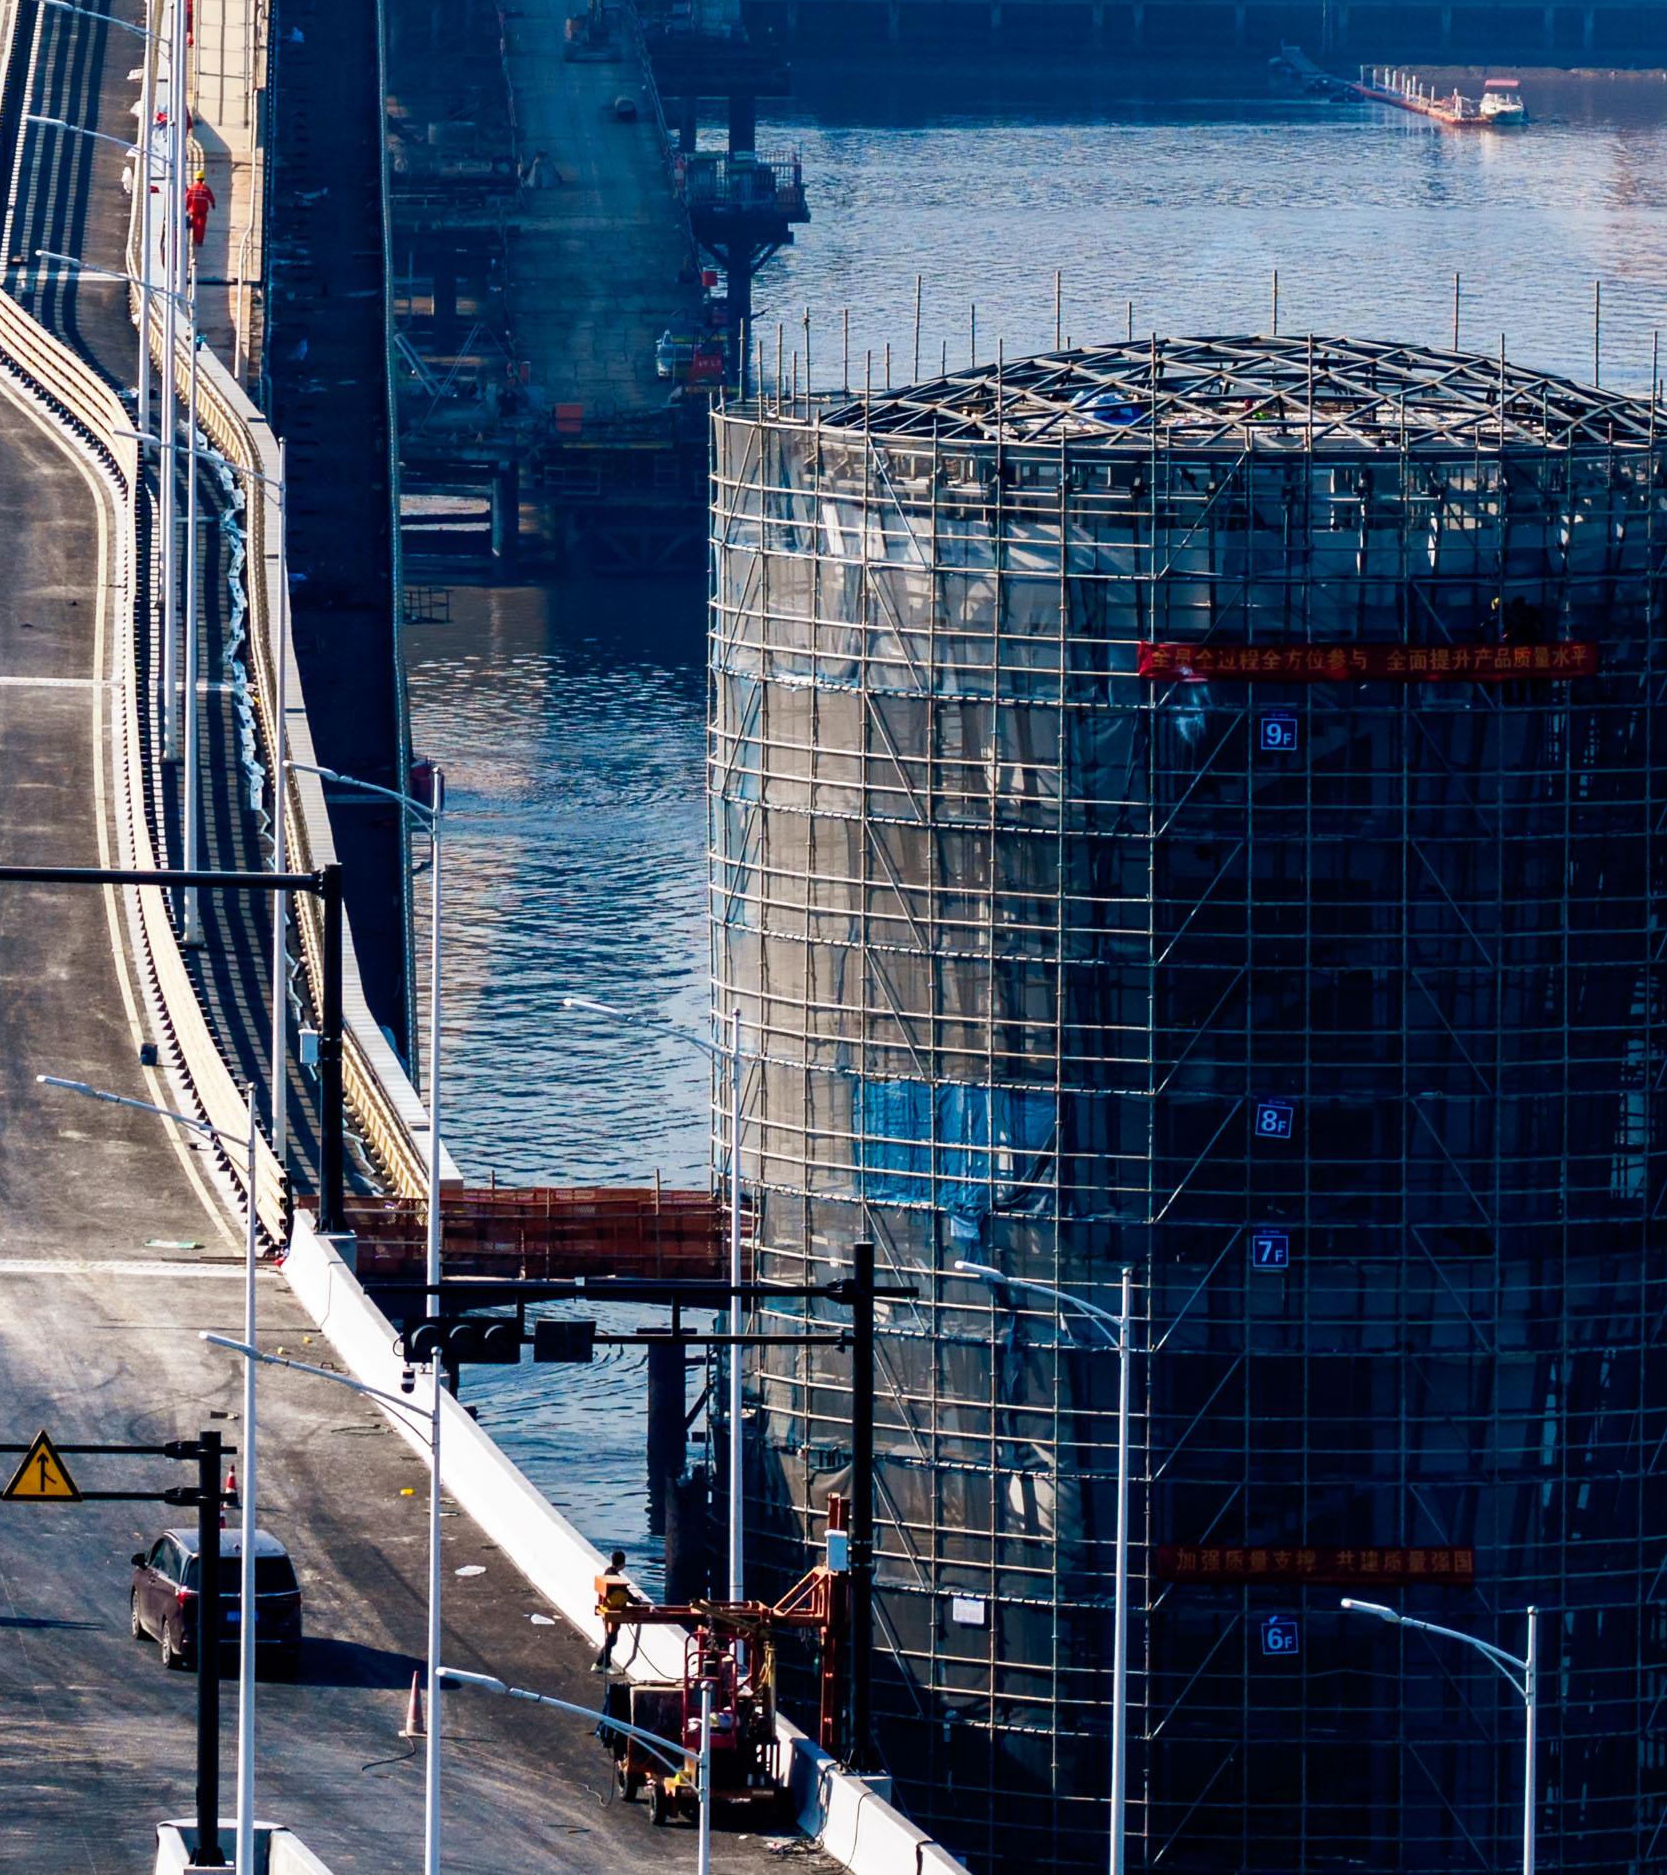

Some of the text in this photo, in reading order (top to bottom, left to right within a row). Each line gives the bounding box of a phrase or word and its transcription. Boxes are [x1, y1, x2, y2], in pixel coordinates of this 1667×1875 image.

[1387, 645, 1588, 671] 全面提升产品质量水平
[1266, 723, 1292, 745] 9F
[1260, 1109, 1287, 1134] 8F
[1258, 1239, 1284, 1264] 7F
[1337, 1549, 1473, 1573] 共建质量强国
[1267, 1626, 1294, 1651] 6F
